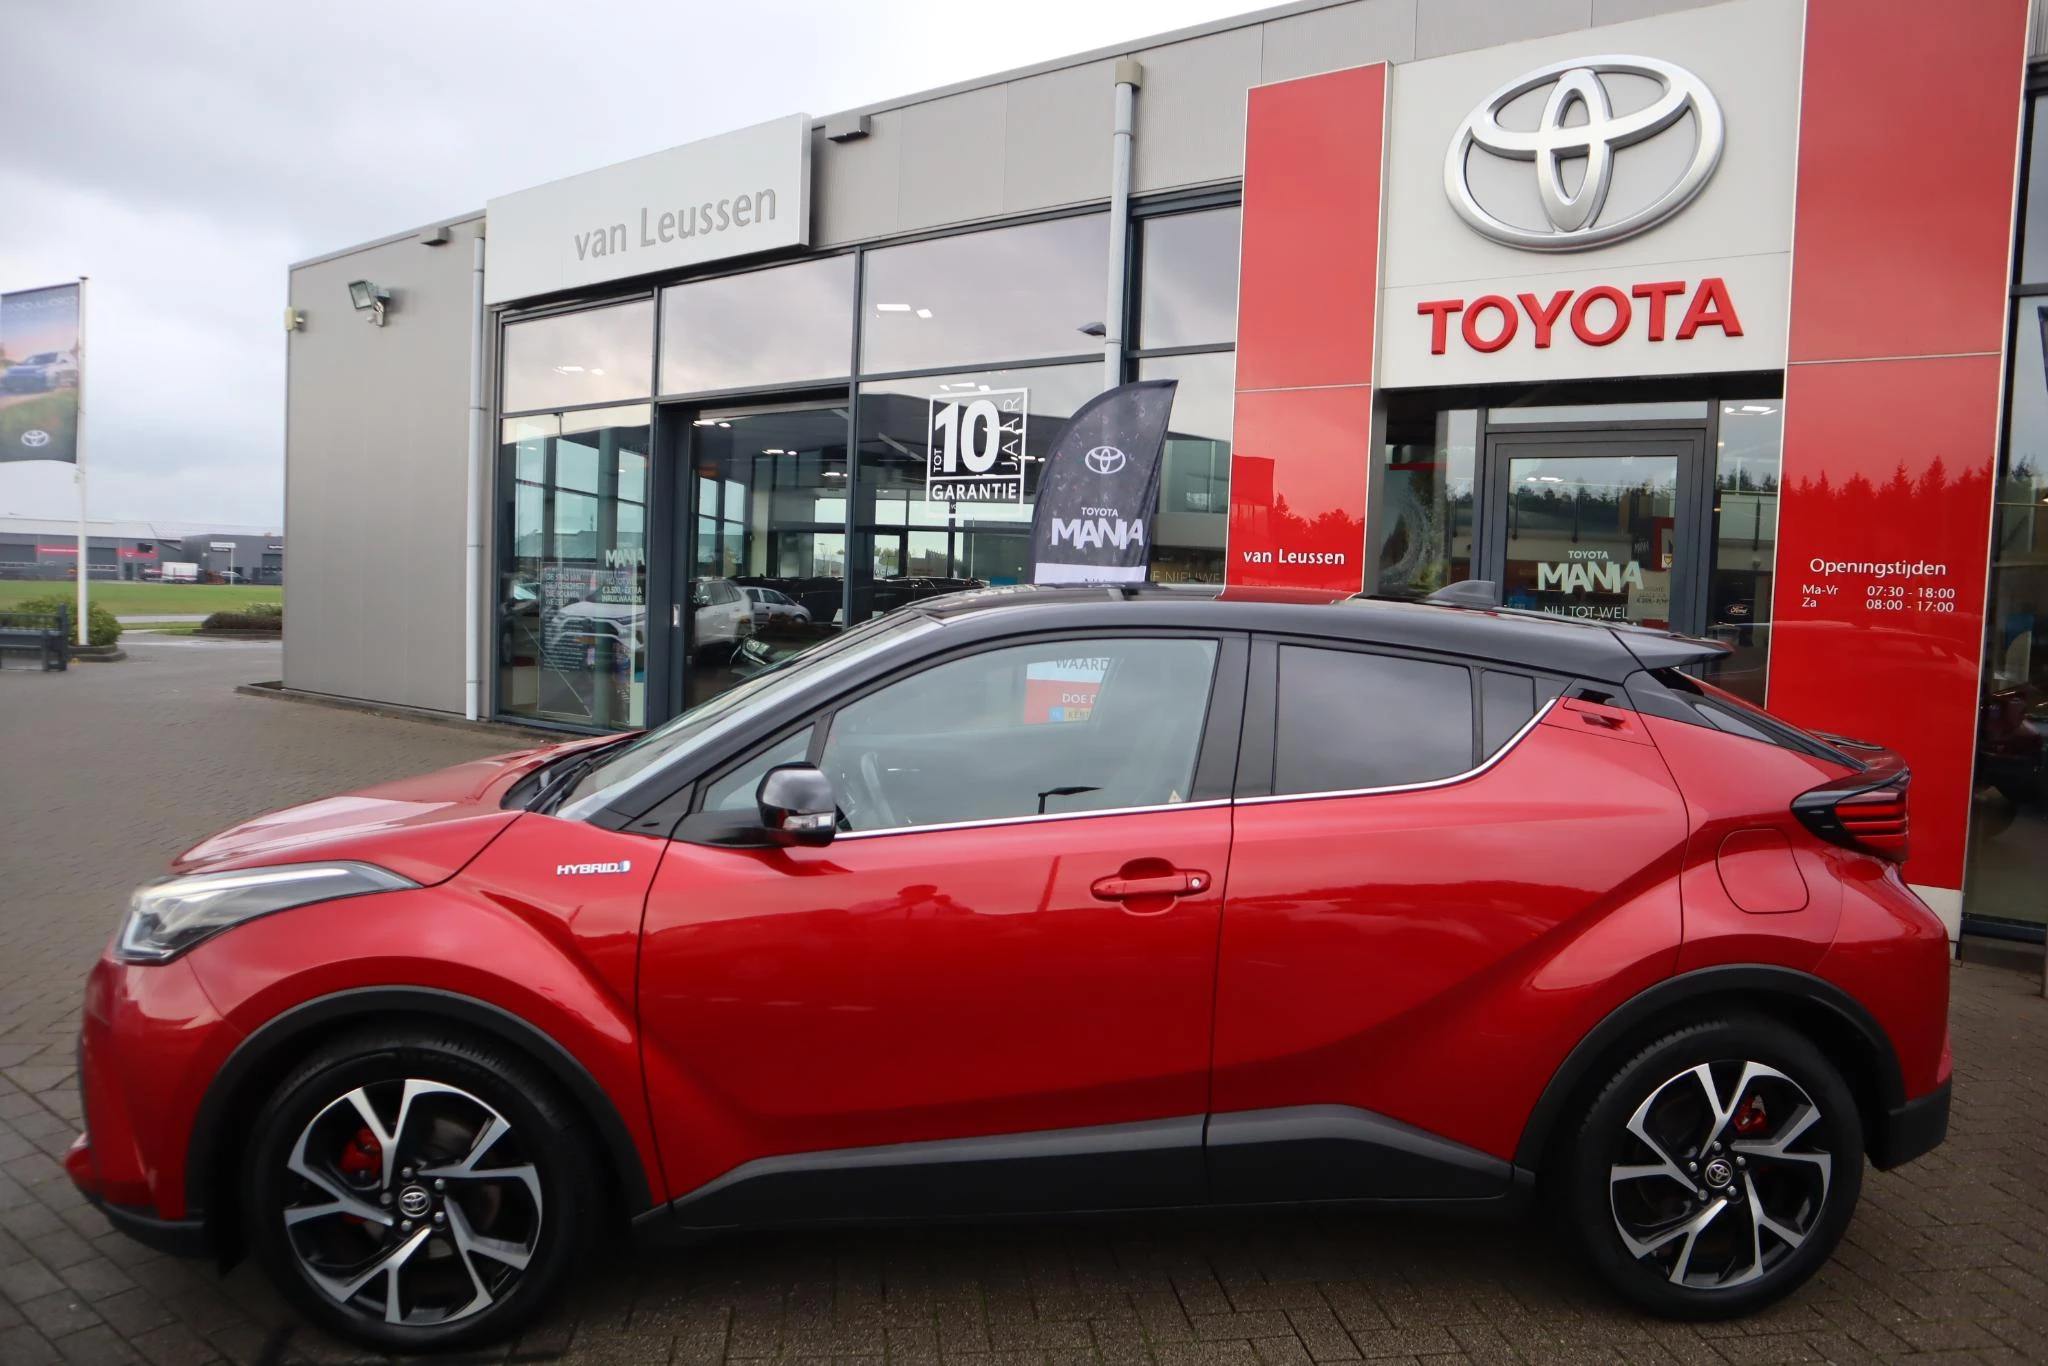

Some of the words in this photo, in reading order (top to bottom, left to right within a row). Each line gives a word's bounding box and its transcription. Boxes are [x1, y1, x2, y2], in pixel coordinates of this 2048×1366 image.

[574, 223, 627, 261] van
[640, 188, 776, 247] Leussen
[1418, 277, 1744, 355] TOYOTA
[935, 399, 1000, 473] 10
[1001, 397, 1020, 471] JAAR
[933, 448, 942, 473] TOT
[932, 483, 1017, 500] GARANTIE
[1081, 507, 1119, 517] TOYOTA
[1051, 518, 1144, 549] MANIA
[1243, 551, 1272, 563] van
[1278, 548, 1345, 565] Leussen
[1568, 550, 1609, 560] TOYOTA
[1537, 560, 1644, 594] MANIA
[1809, 558, 1947, 579] Openingstijden
[1802, 584, 1839, 595] Ma-Vr
[1867, 585, 1904, 597] 07:30
[1918, 587, 1955, 599] 18:00
[1570, 605, 1596, 618] TOT
[1599, 606, 1628, 619] WEL
[1802, 597, 1817, 608] Za
[1866, 599, 1903, 610] 08:00
[1917, 601, 1954, 612] 17:00
[1062, 693, 1087, 704] DOE
[557, 863, 618, 875] HYBRID
